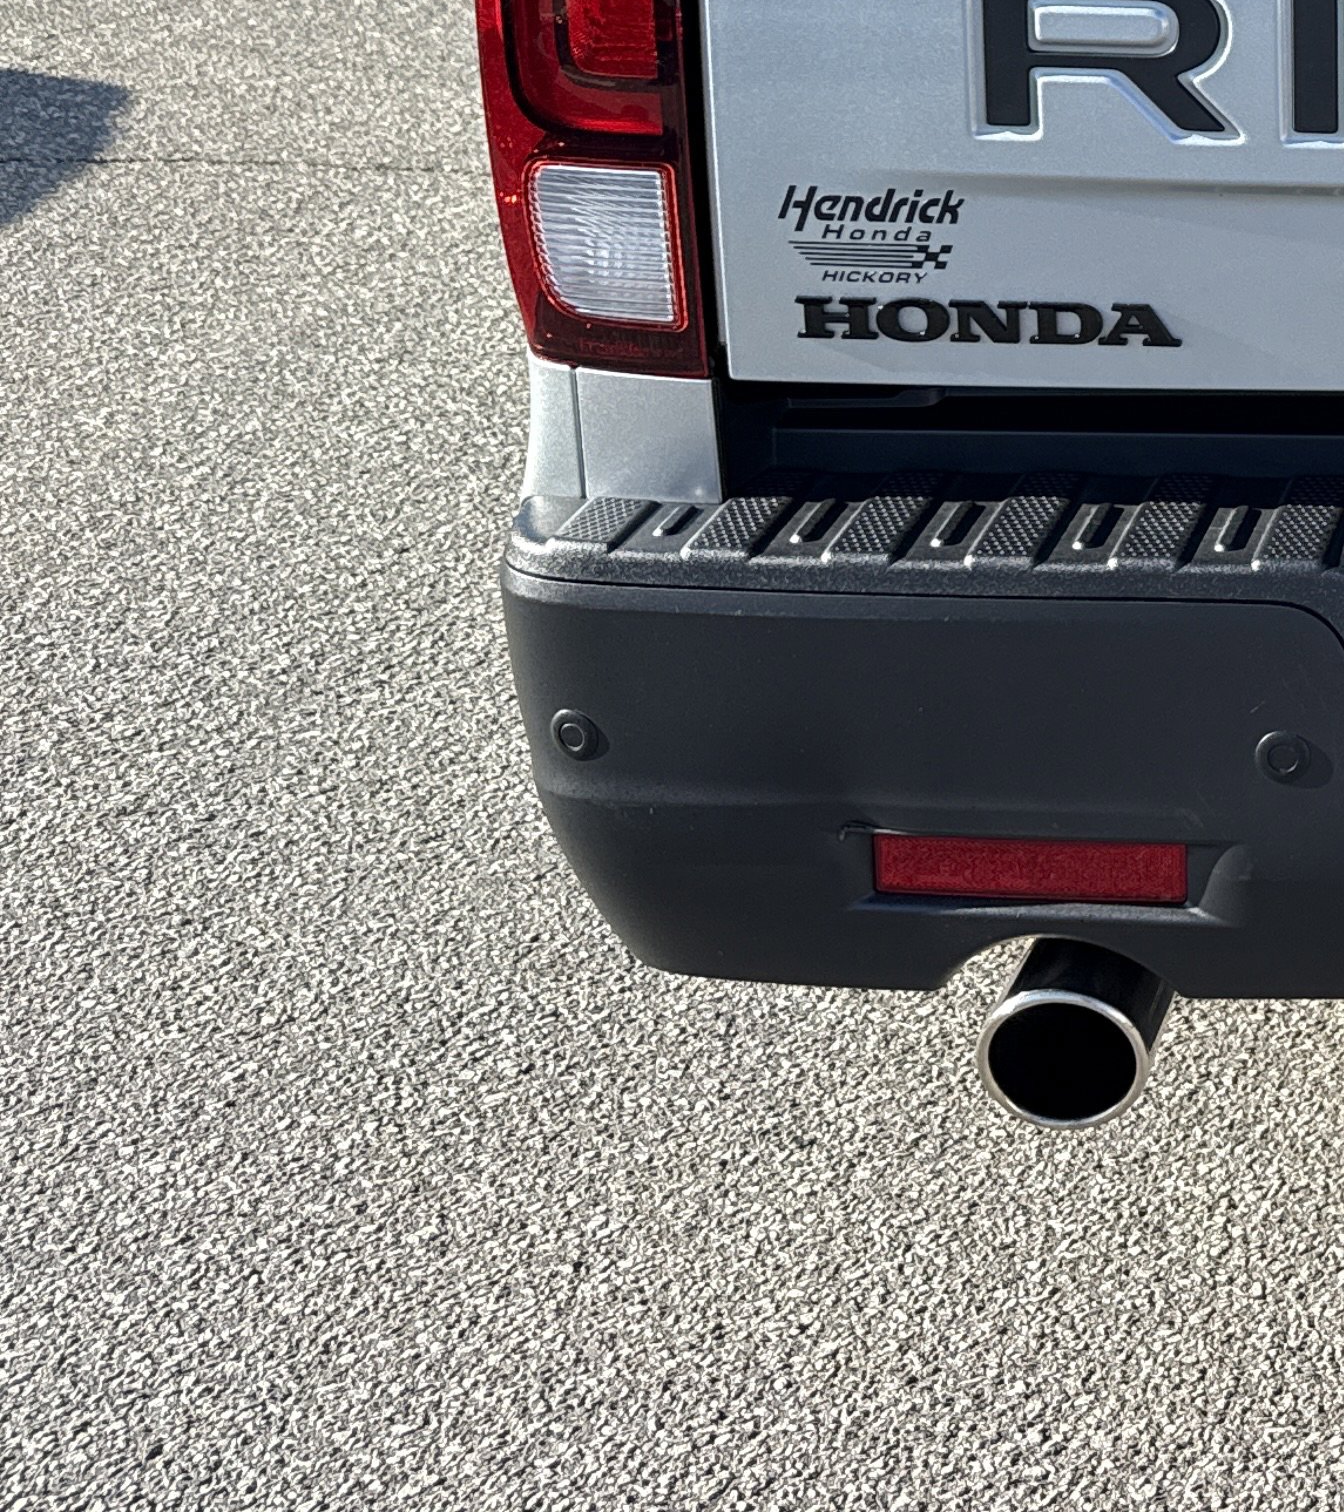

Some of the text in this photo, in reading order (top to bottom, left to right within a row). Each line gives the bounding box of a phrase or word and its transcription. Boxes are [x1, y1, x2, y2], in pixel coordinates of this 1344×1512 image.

[778, 185, 965, 231] Hendrick
[821, 224, 932, 242] Honda
[821, 270, 928, 284] HICKORY
[794, 296, 1182, 347] HONDA
